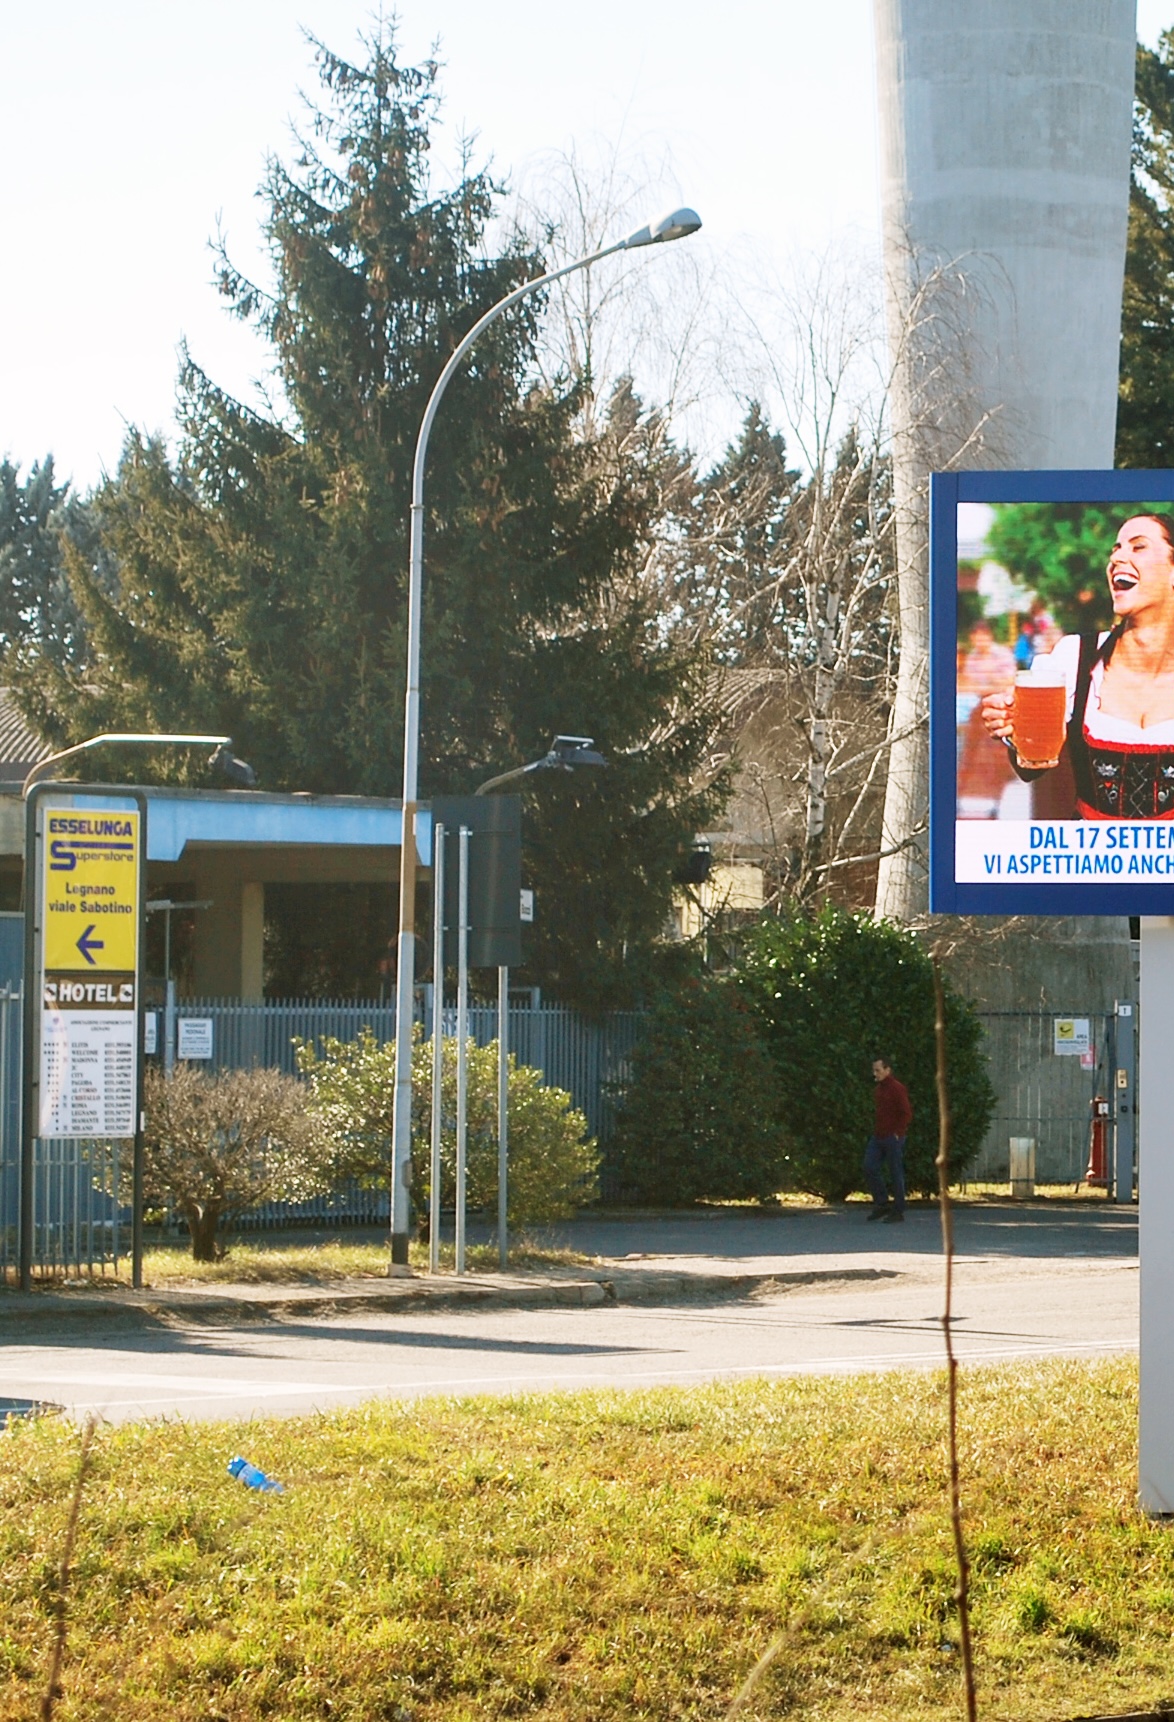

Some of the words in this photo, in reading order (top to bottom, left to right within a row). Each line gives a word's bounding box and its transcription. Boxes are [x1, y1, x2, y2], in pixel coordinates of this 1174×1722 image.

[49, 818, 133, 837] ESSELUNGA
[1029, 827, 1069, 849] DAL
[1074, 827, 1100, 849] 17
[50, 841, 134, 870] Superstore
[984, 855, 1002, 874] VI
[1006, 854, 1124, 875] ASPETTIAMO
[65, 882, 116, 897] Legnano
[49, 900, 76, 912] viale
[80, 901, 133, 914] Sabotino
[59, 983, 116, 1003] HOTEL
